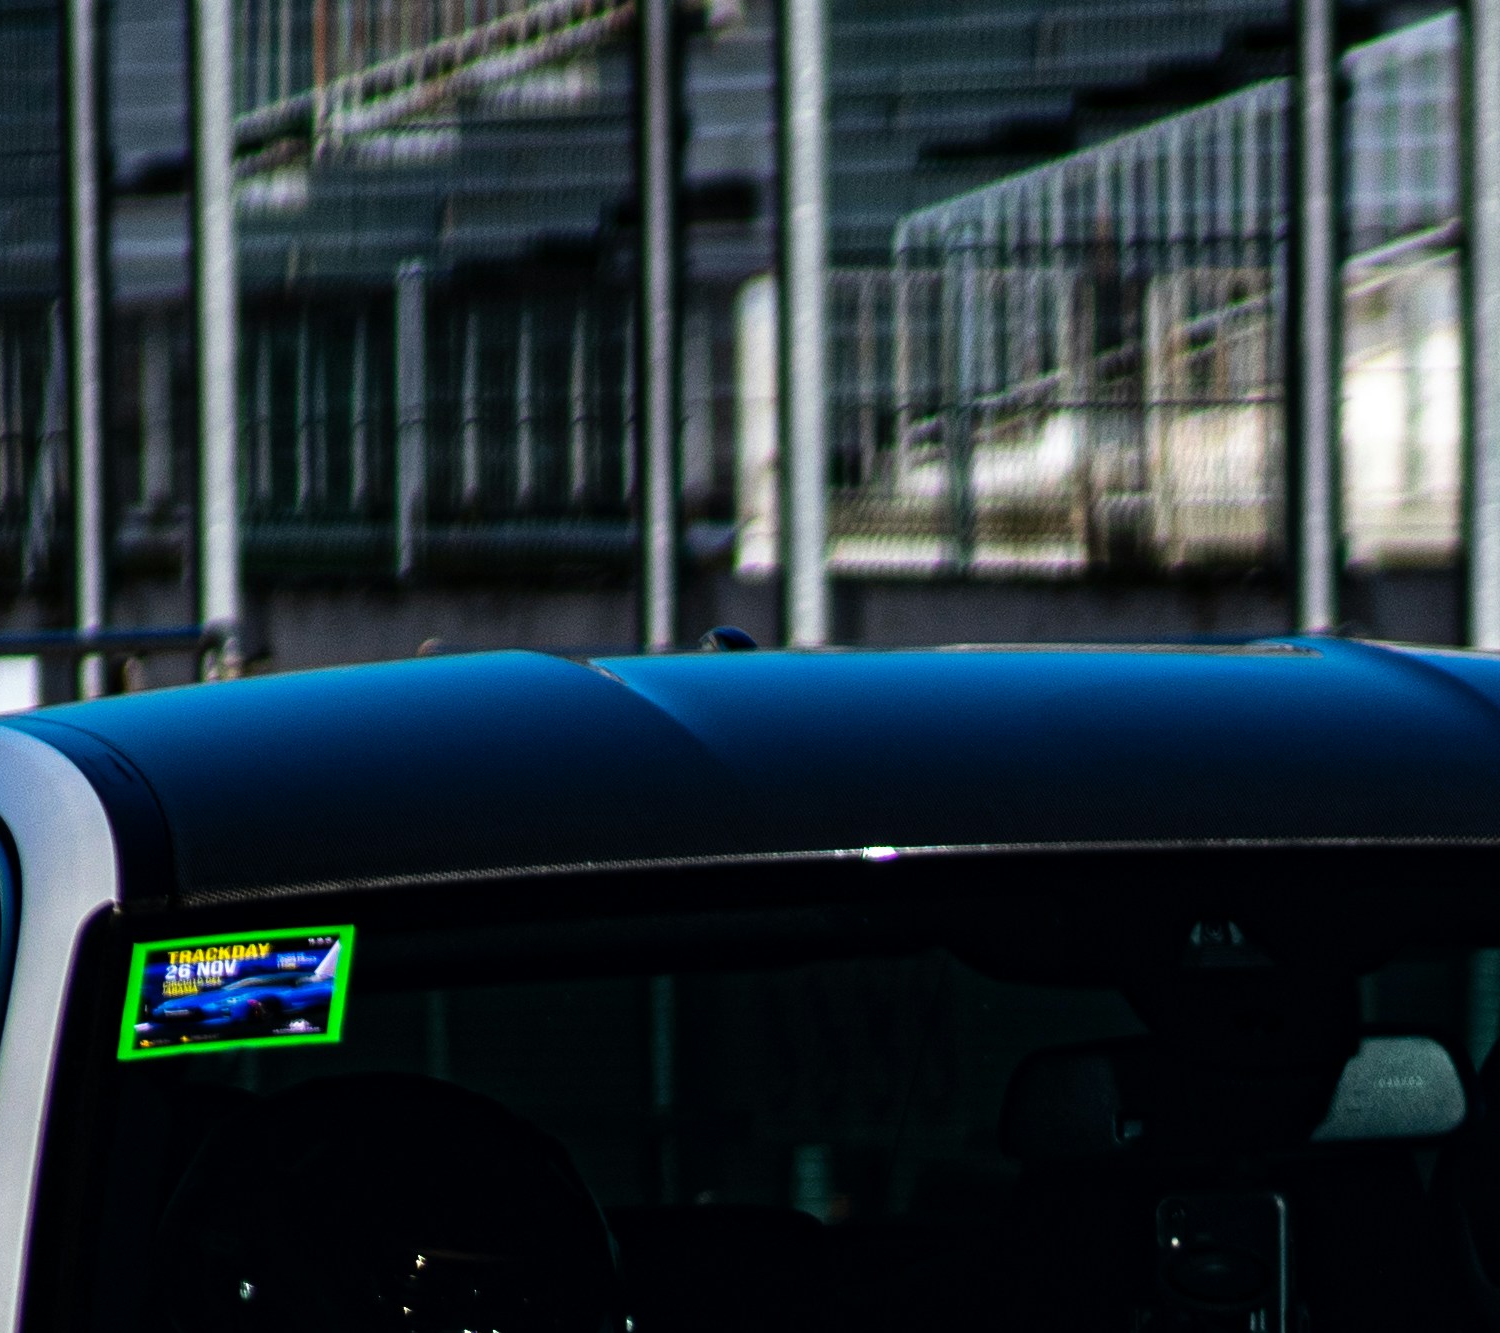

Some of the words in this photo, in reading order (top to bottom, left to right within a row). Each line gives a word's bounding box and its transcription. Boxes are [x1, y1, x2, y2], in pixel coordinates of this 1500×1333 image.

[167, 943, 271, 965] TRACKDAY
[164, 964, 191, 979] 26
[197, 959, 238, 977] NOV
